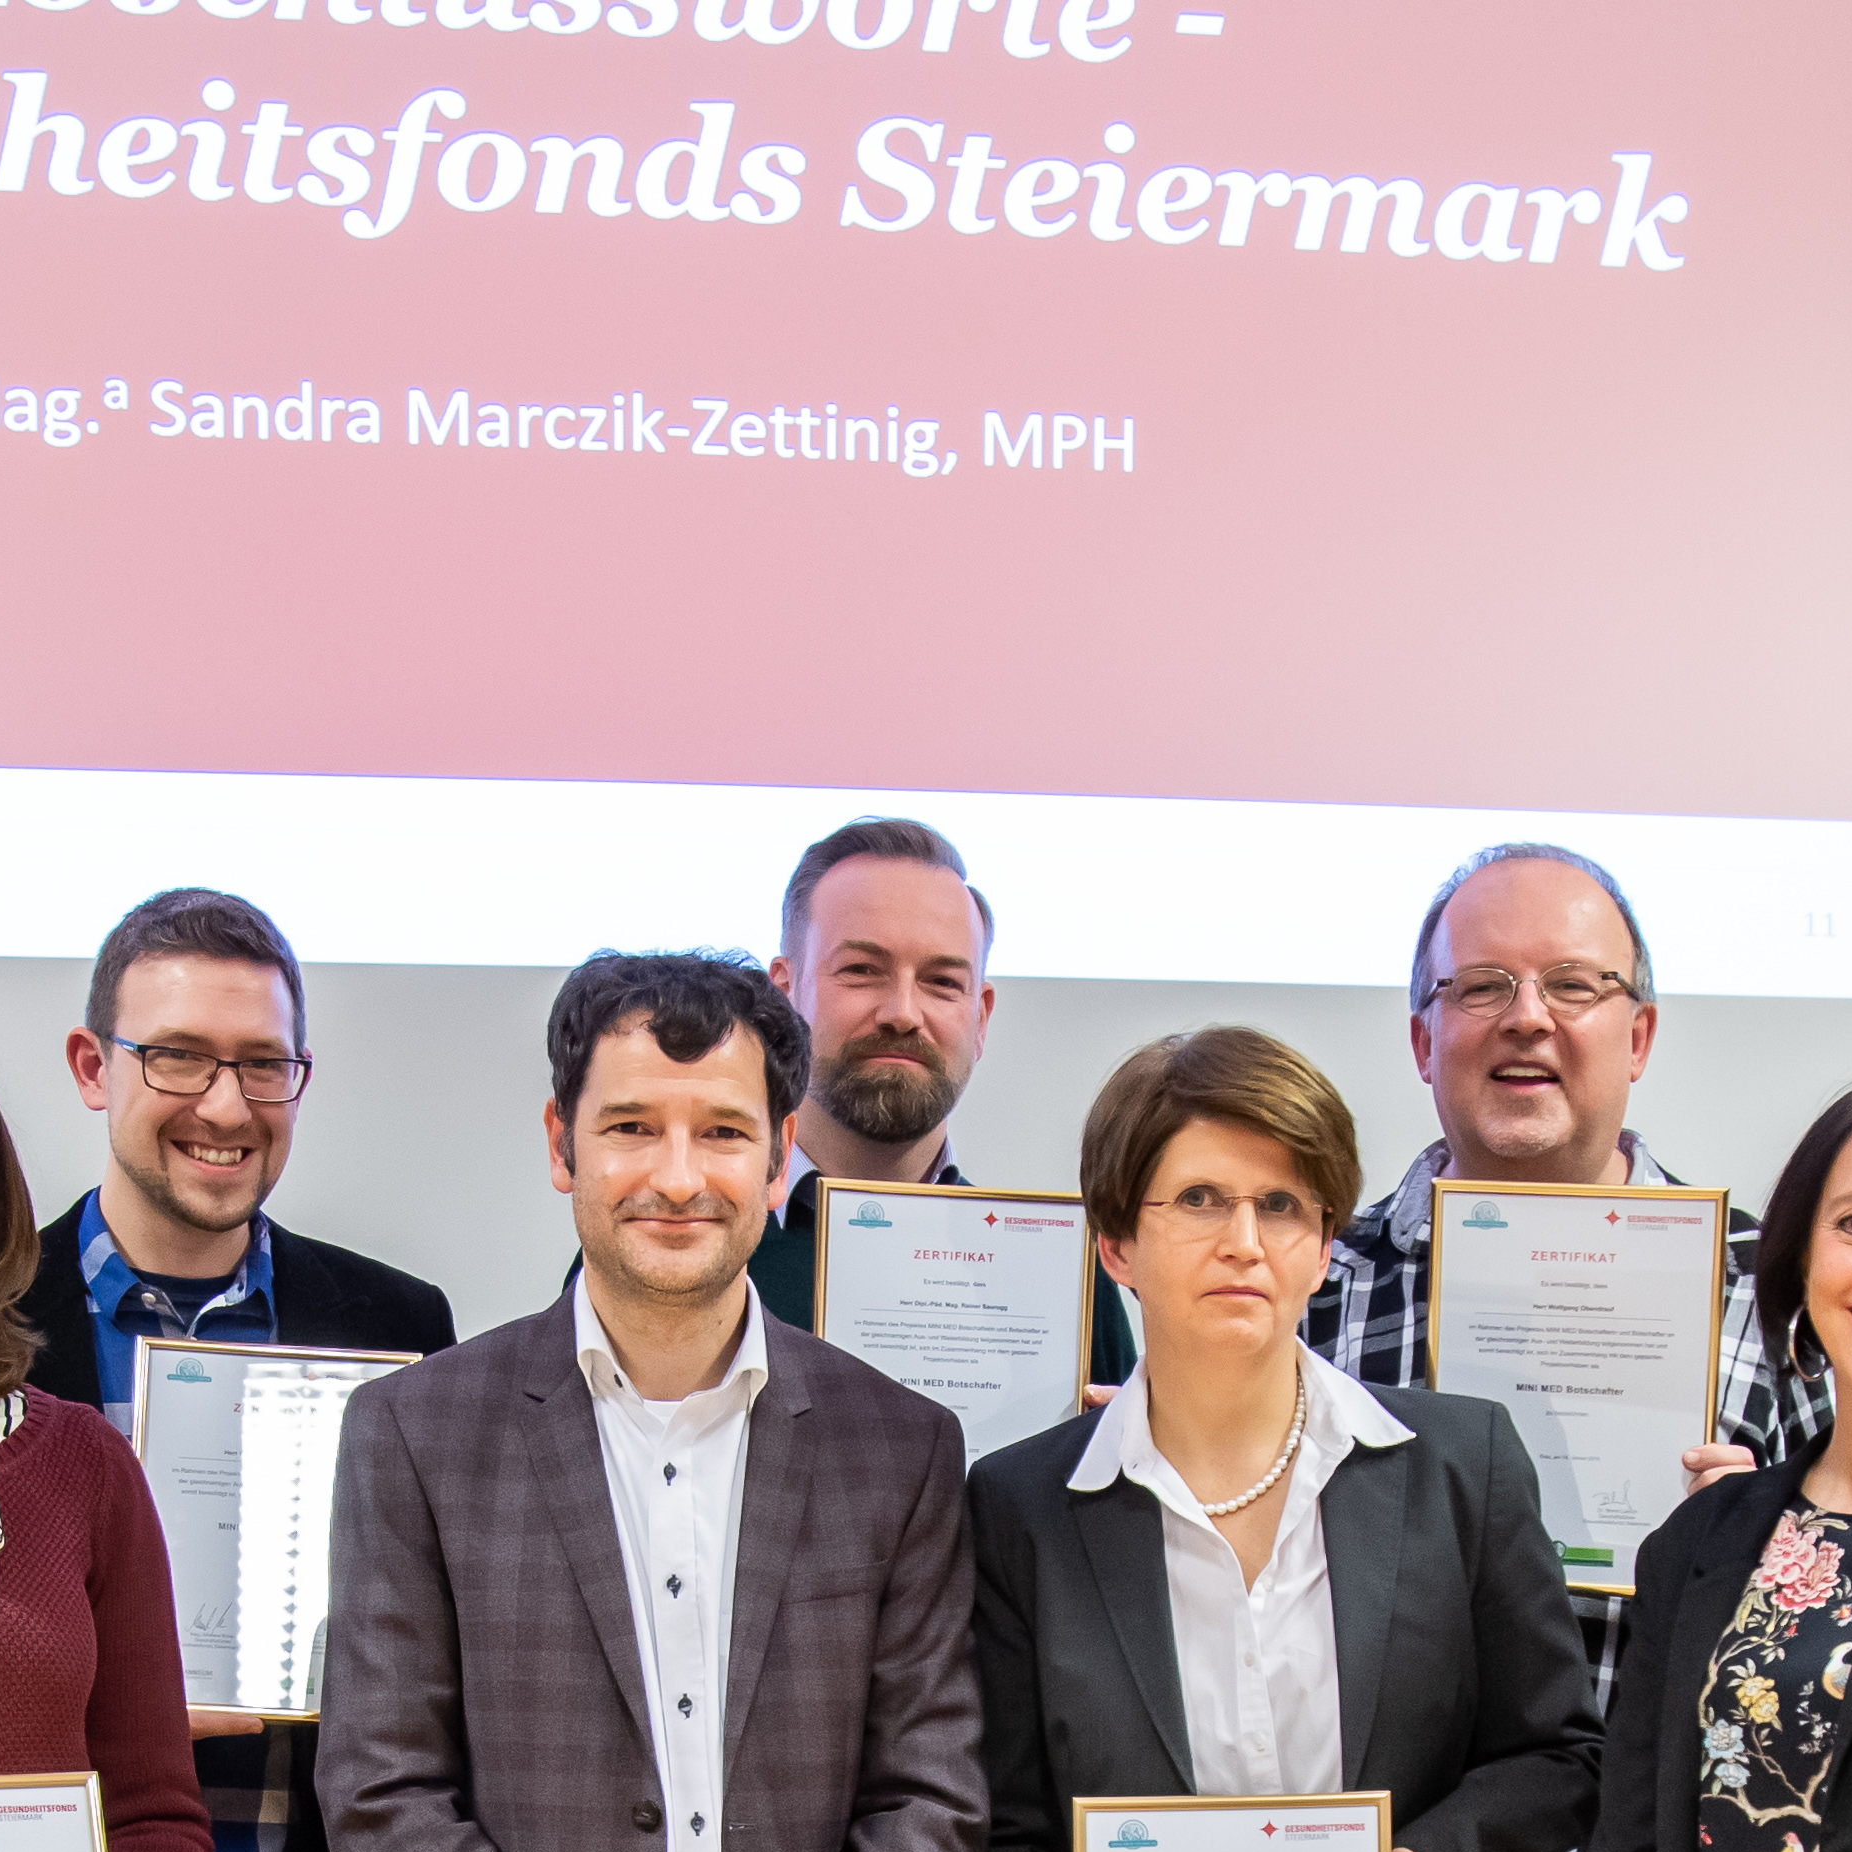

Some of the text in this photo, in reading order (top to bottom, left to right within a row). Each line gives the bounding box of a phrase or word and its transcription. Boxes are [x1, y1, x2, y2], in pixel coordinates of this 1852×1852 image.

[841, 115, 1688, 271] Steiermark
[151, 382, 379, 443] Sandra
[409, 390, 956, 477] Marczik-Zettinig,
[984, 413, 1133, 472] MPH
[912, 1248, 995, 1263] ZERTIFIKAT
[1529, 1249, 1617, 1264] ZERTIFIKAT
[899, 1377, 1002, 1390] MINI MED Botschafter
[1516, 1383, 1625, 1396] MINI MED Botschafter
[1284, 1822, 1366, 1833] GESUNDHEITSFONDS
